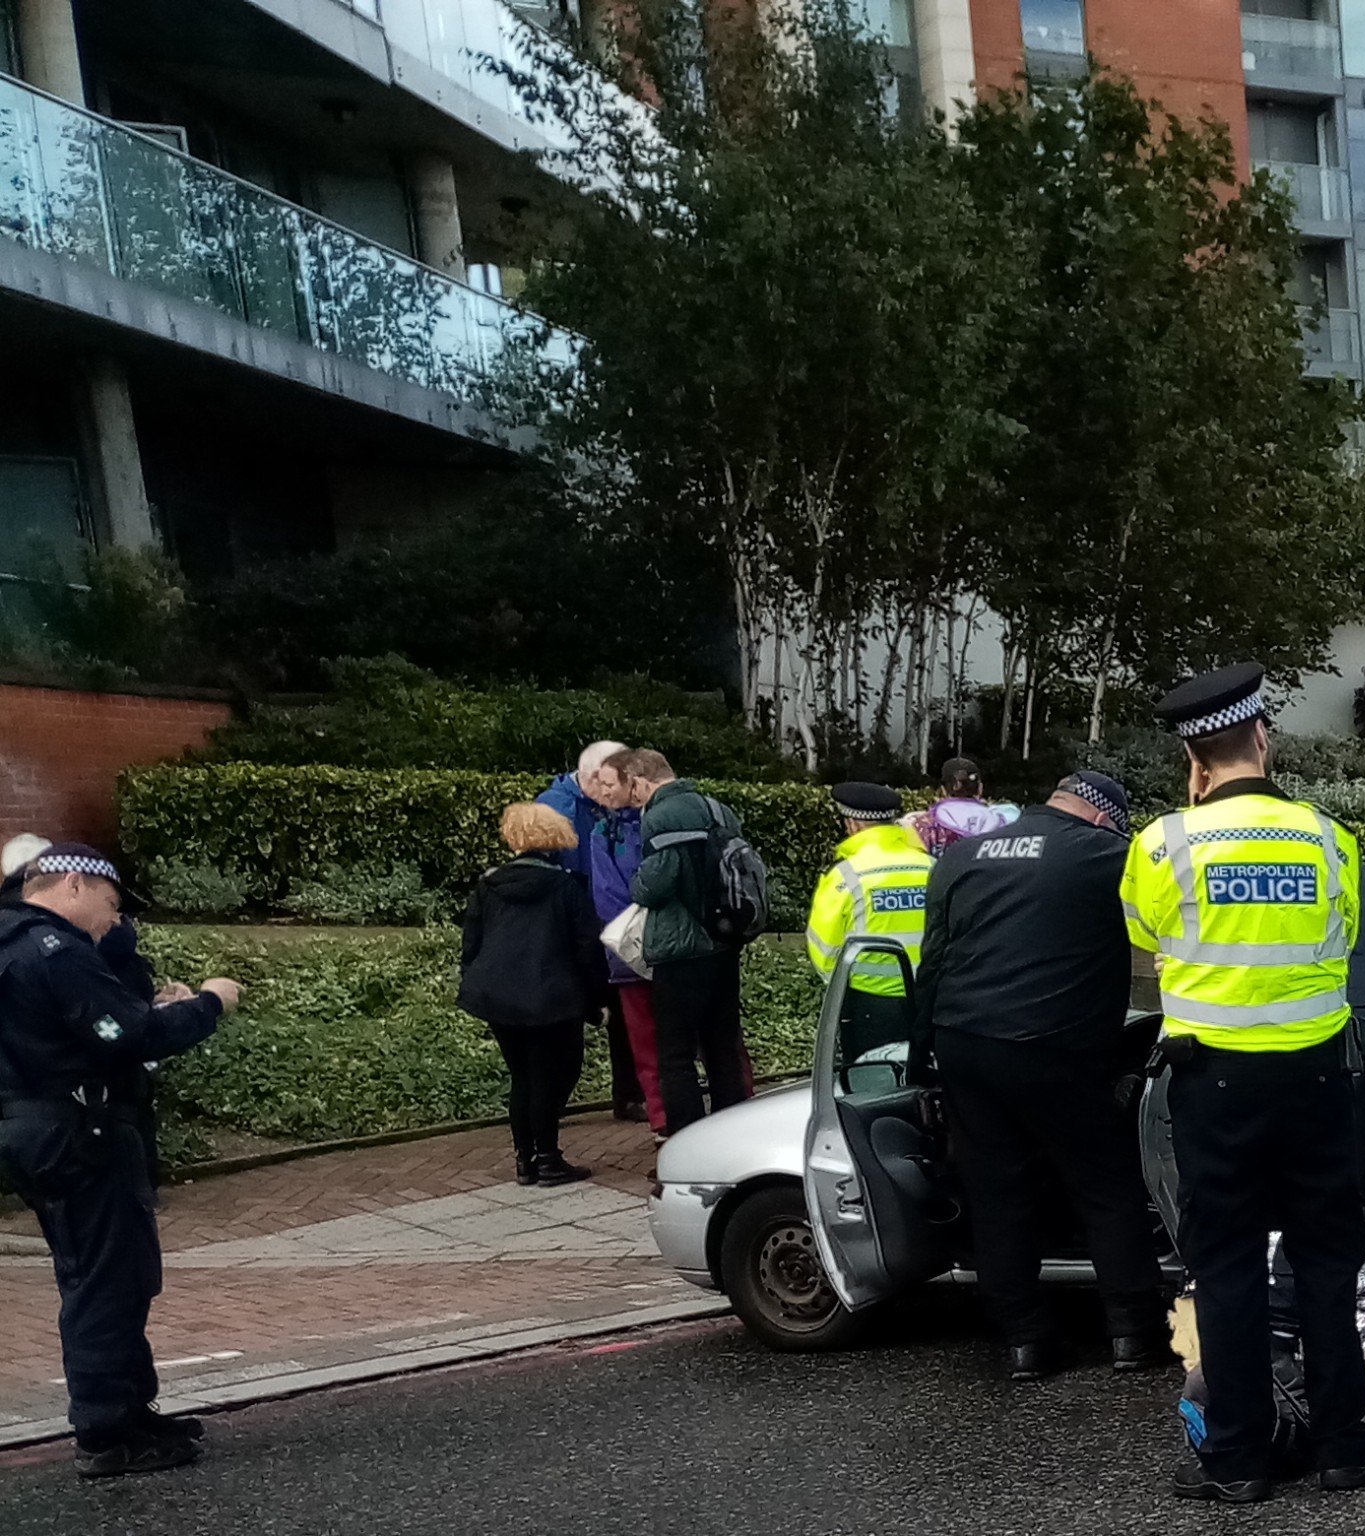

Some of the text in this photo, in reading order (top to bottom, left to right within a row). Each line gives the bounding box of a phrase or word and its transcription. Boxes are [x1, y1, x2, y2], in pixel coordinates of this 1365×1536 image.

[976, 836, 1043, 859] POLICE
[1206, 865, 1316, 878] METROPOLITAN
[1208, 878, 1316, 902] POLICE
[873, 894, 926, 911] POLIC
